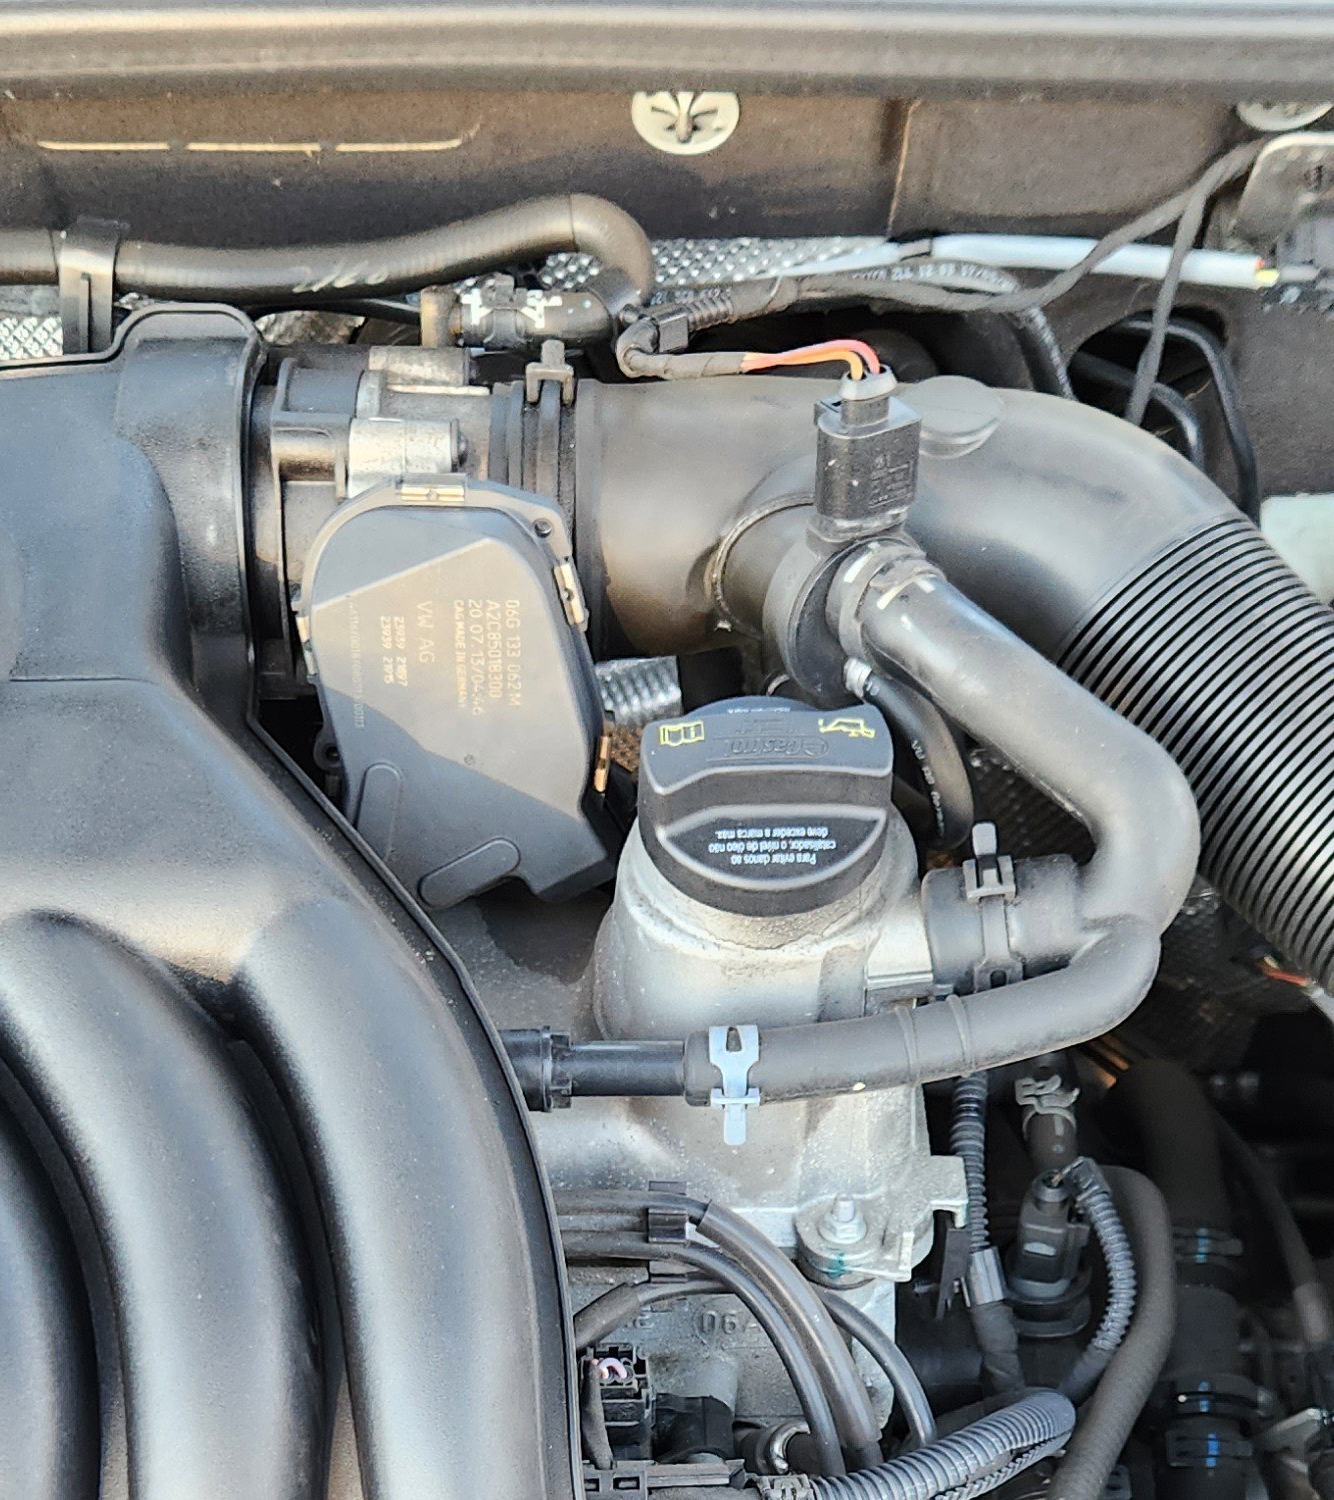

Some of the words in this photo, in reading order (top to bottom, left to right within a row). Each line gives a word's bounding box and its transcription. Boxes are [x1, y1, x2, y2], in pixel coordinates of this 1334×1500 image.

[417, 601, 434, 628] VW
[505, 600, 521, 629] 06G
[454, 620, 466, 649] MADE
[419, 637, 436, 664] AG
[506, 633, 522, 659] 133
[456, 649, 467, 664] IN
[722, 737, 803, 758] Castrol
[736, 828, 763, 838] marca
[746, 841, 758, 853] de
[730, 854, 742, 865] ao
[743, 853, 770, 865] danos
[771, 853, 795, 865] evitar
[796, 853, 817, 865] Para
